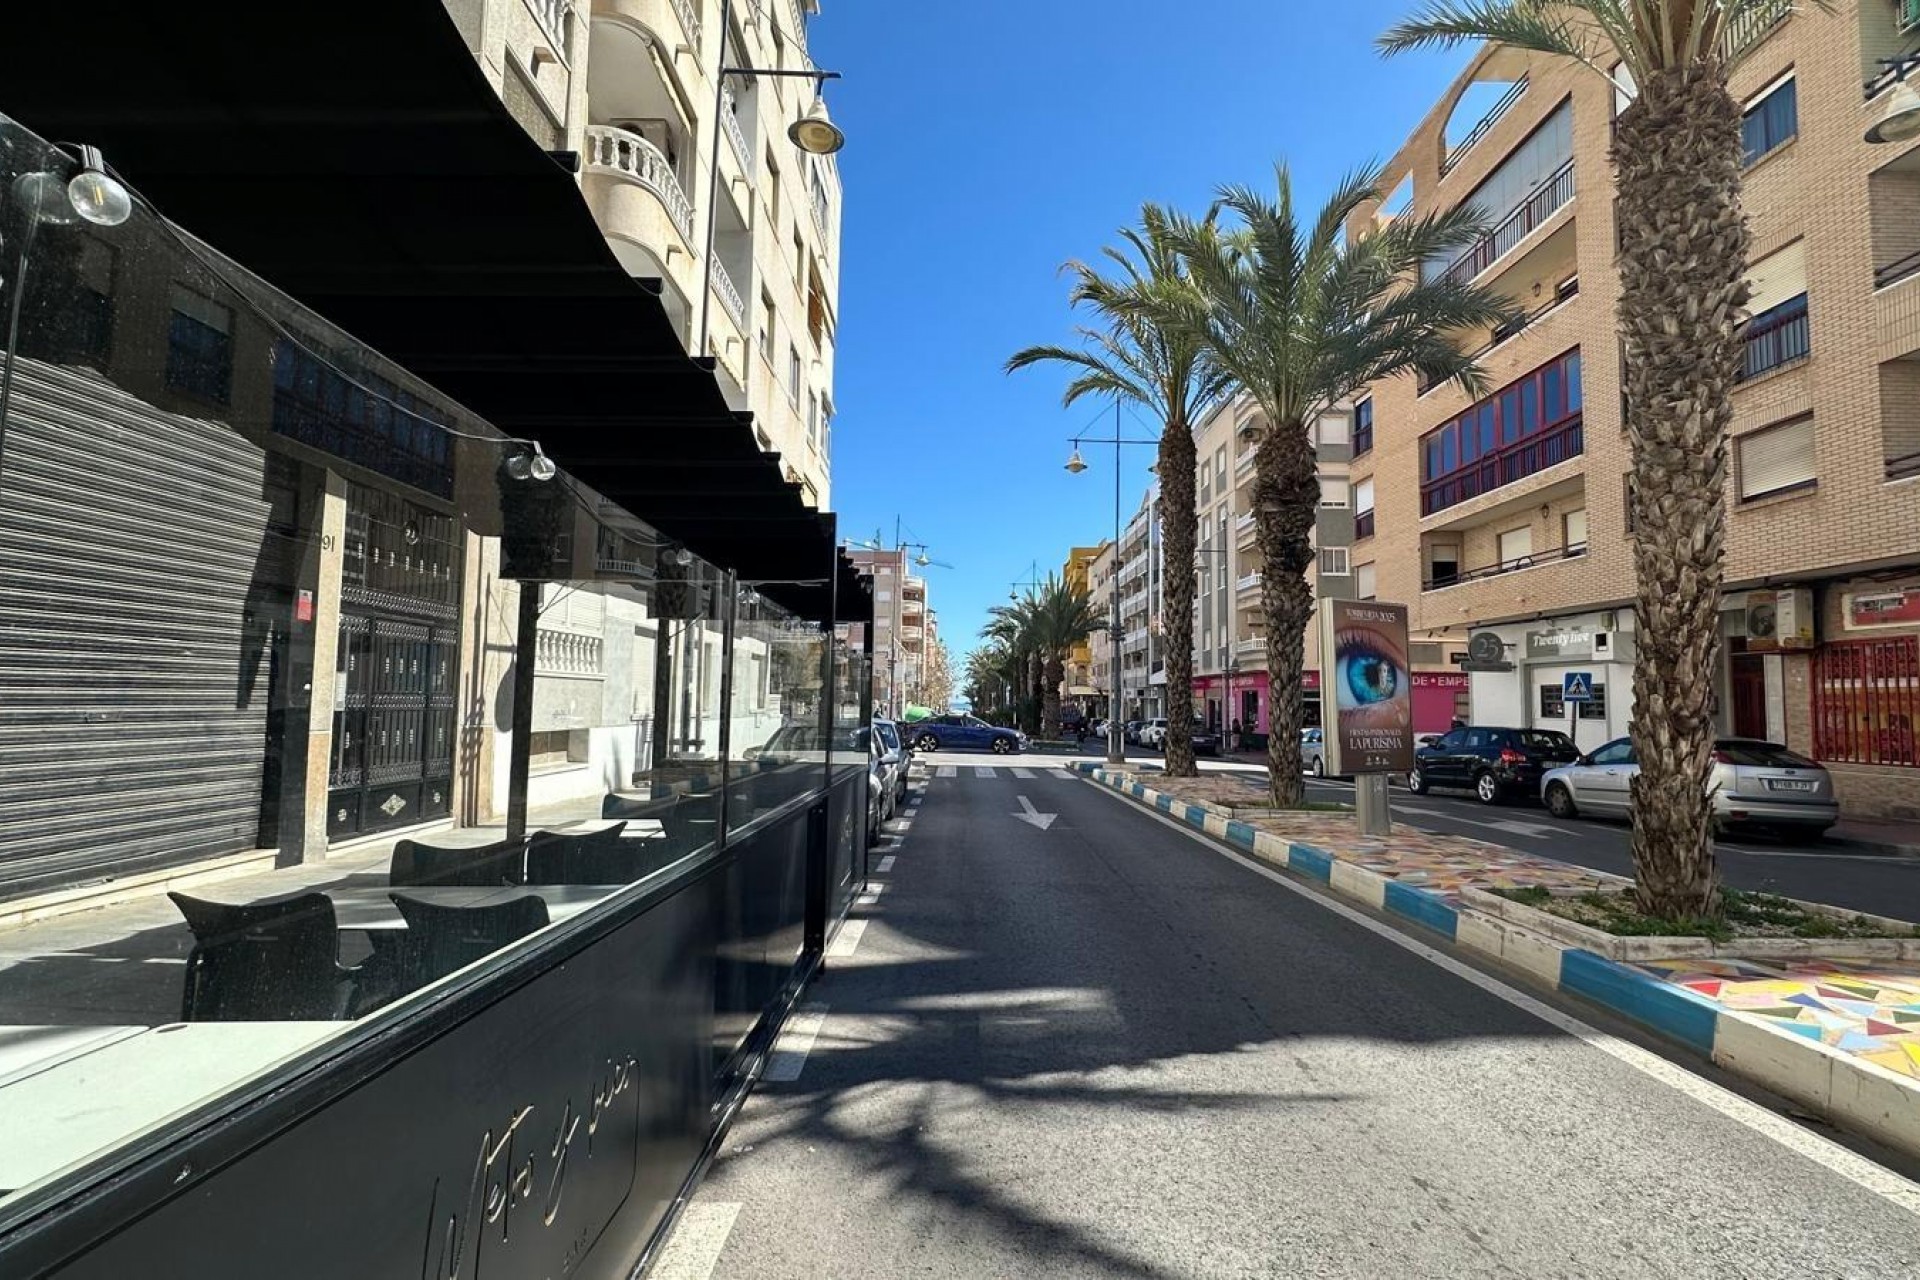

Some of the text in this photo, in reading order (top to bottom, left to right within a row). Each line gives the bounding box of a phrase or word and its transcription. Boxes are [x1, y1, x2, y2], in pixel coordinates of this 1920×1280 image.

[1477, 638, 1498, 658] 25
[1412, 676, 1427, 686] DE
[1349, 737, 1362, 749] LA
